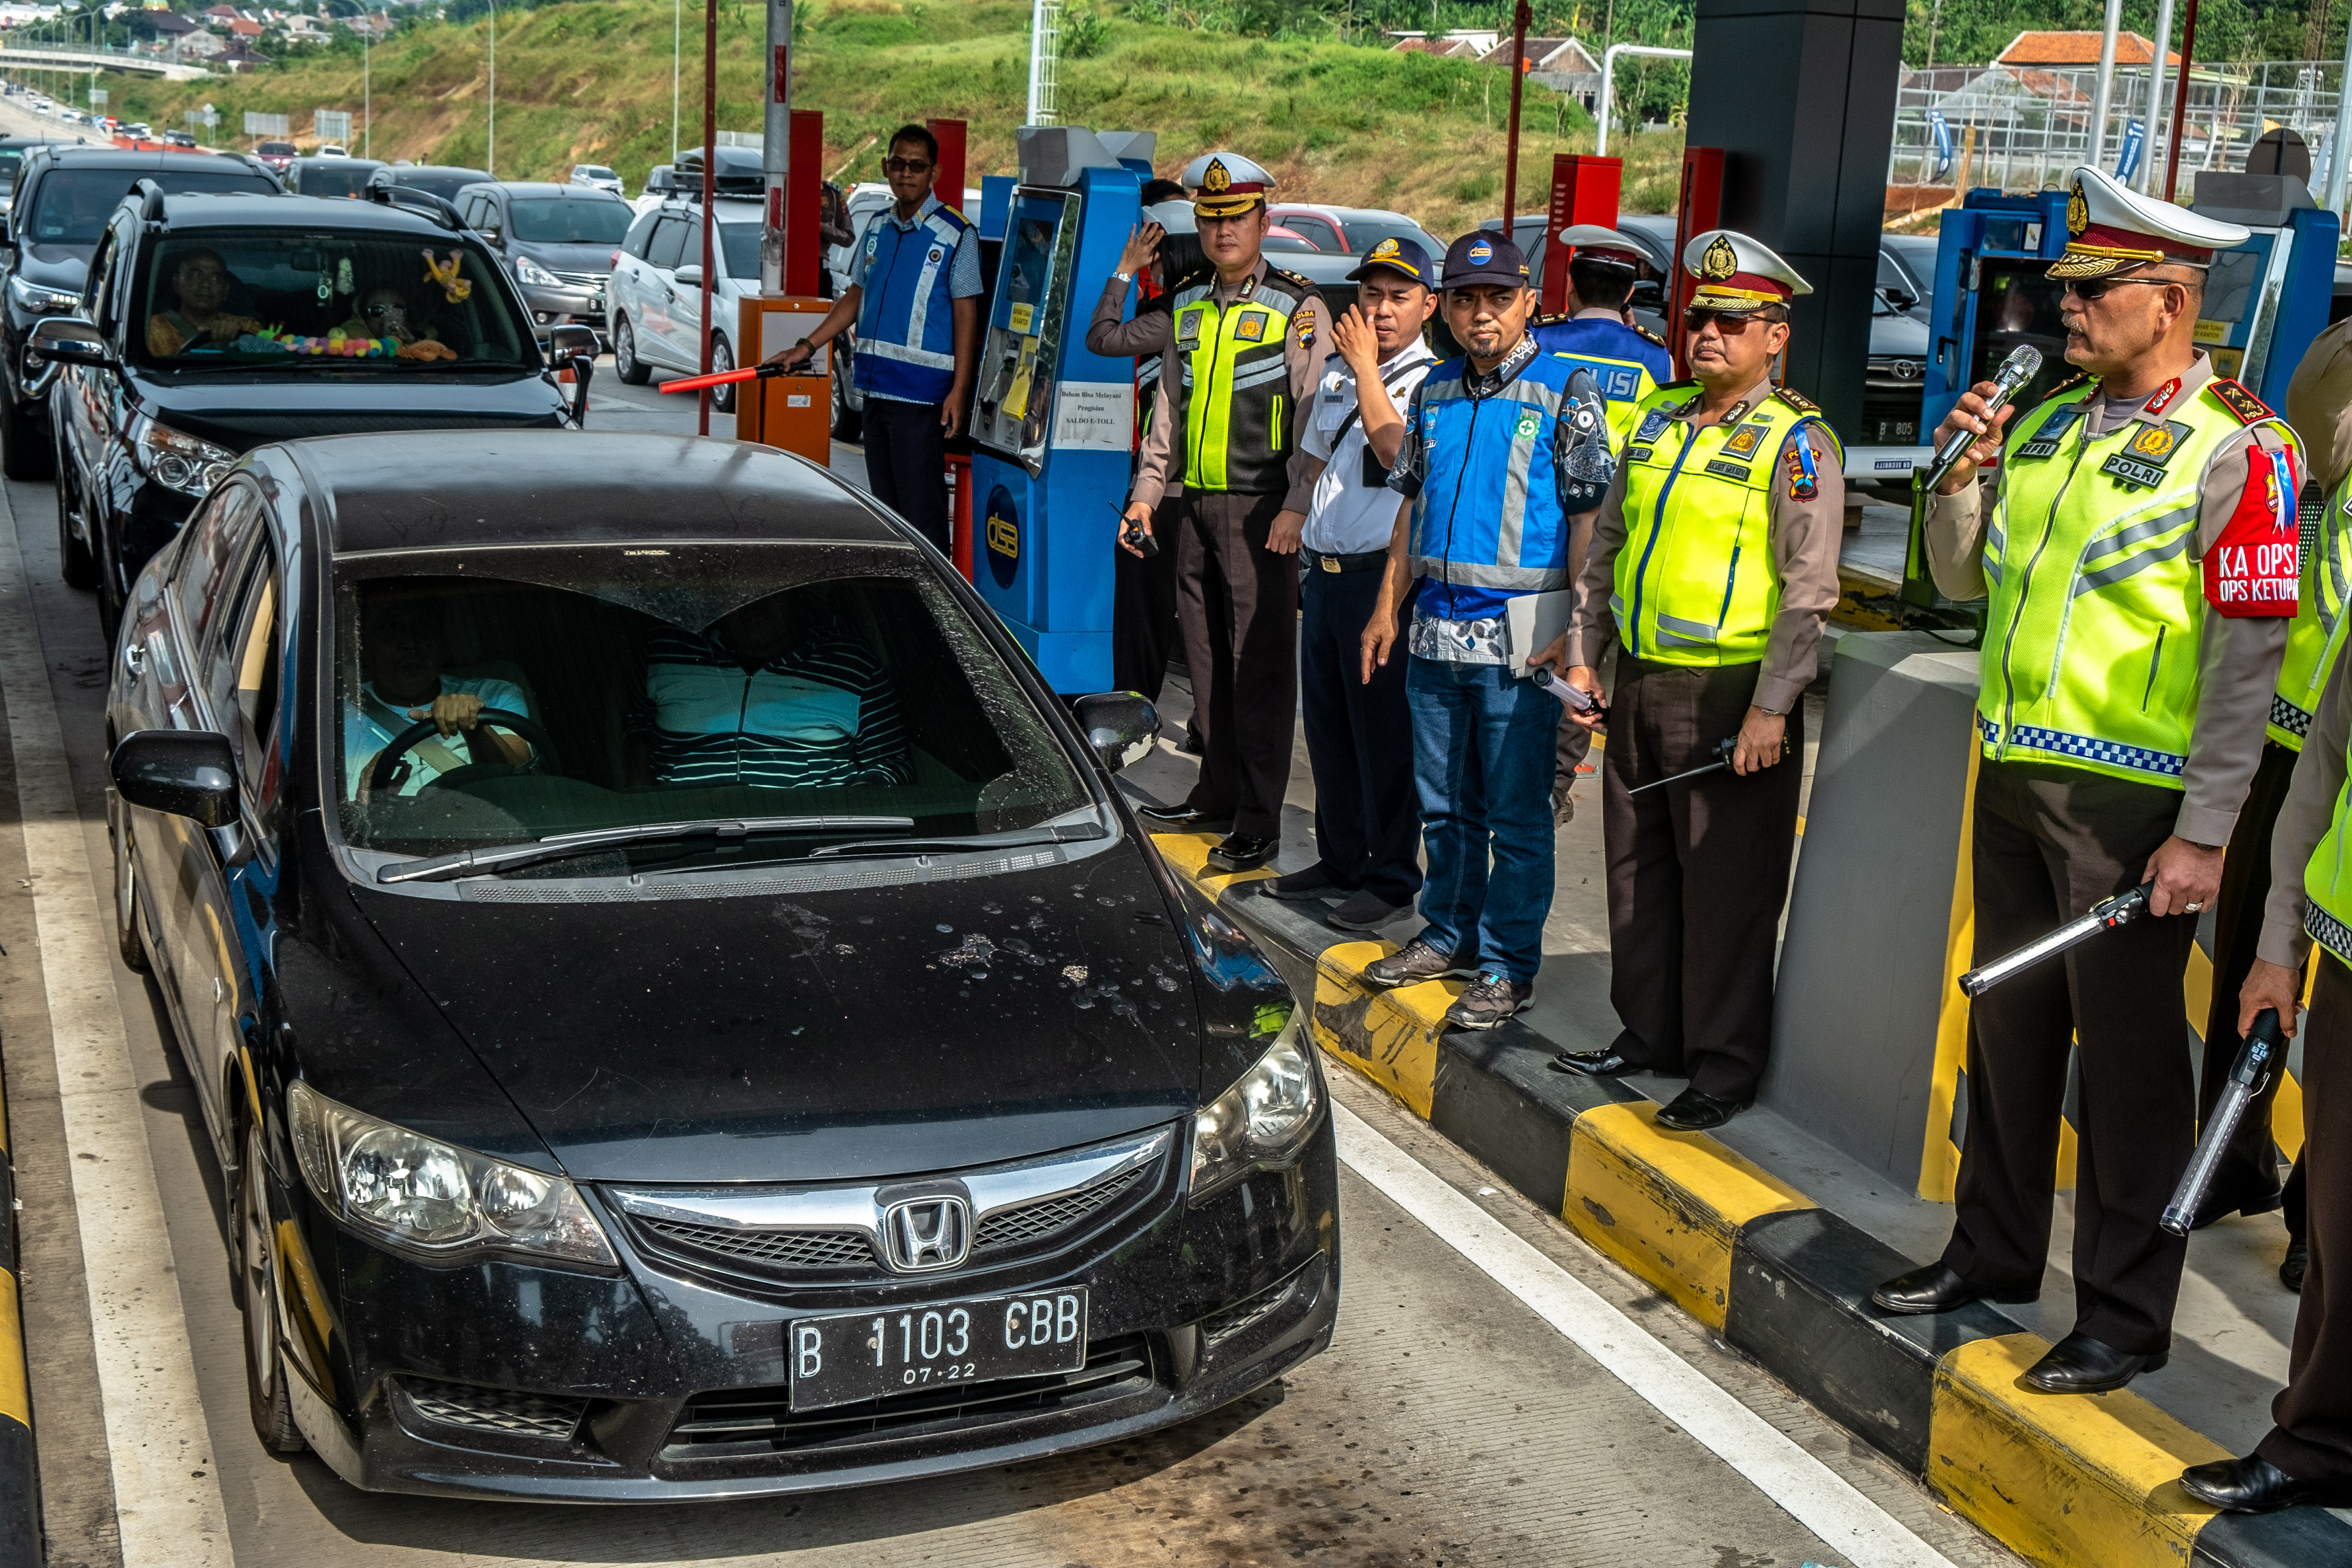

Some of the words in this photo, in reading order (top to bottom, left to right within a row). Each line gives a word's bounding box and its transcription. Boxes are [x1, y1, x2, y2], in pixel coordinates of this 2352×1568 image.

[590, 299, 596, 310] B
[1880, 422, 1886, 434] B
[1896, 423, 1912, 434] 805
[2106, 457, 2161, 483] POLRI
[2219, 546, 2249, 578] KA
[2257, 543, 2294, 576] OPS
[2219, 579, 2248, 602] OPS
[798, 1328, 821, 1378] B
[873, 1309, 970, 1367] 1103
[1005, 1295, 1079, 1349] CBB
